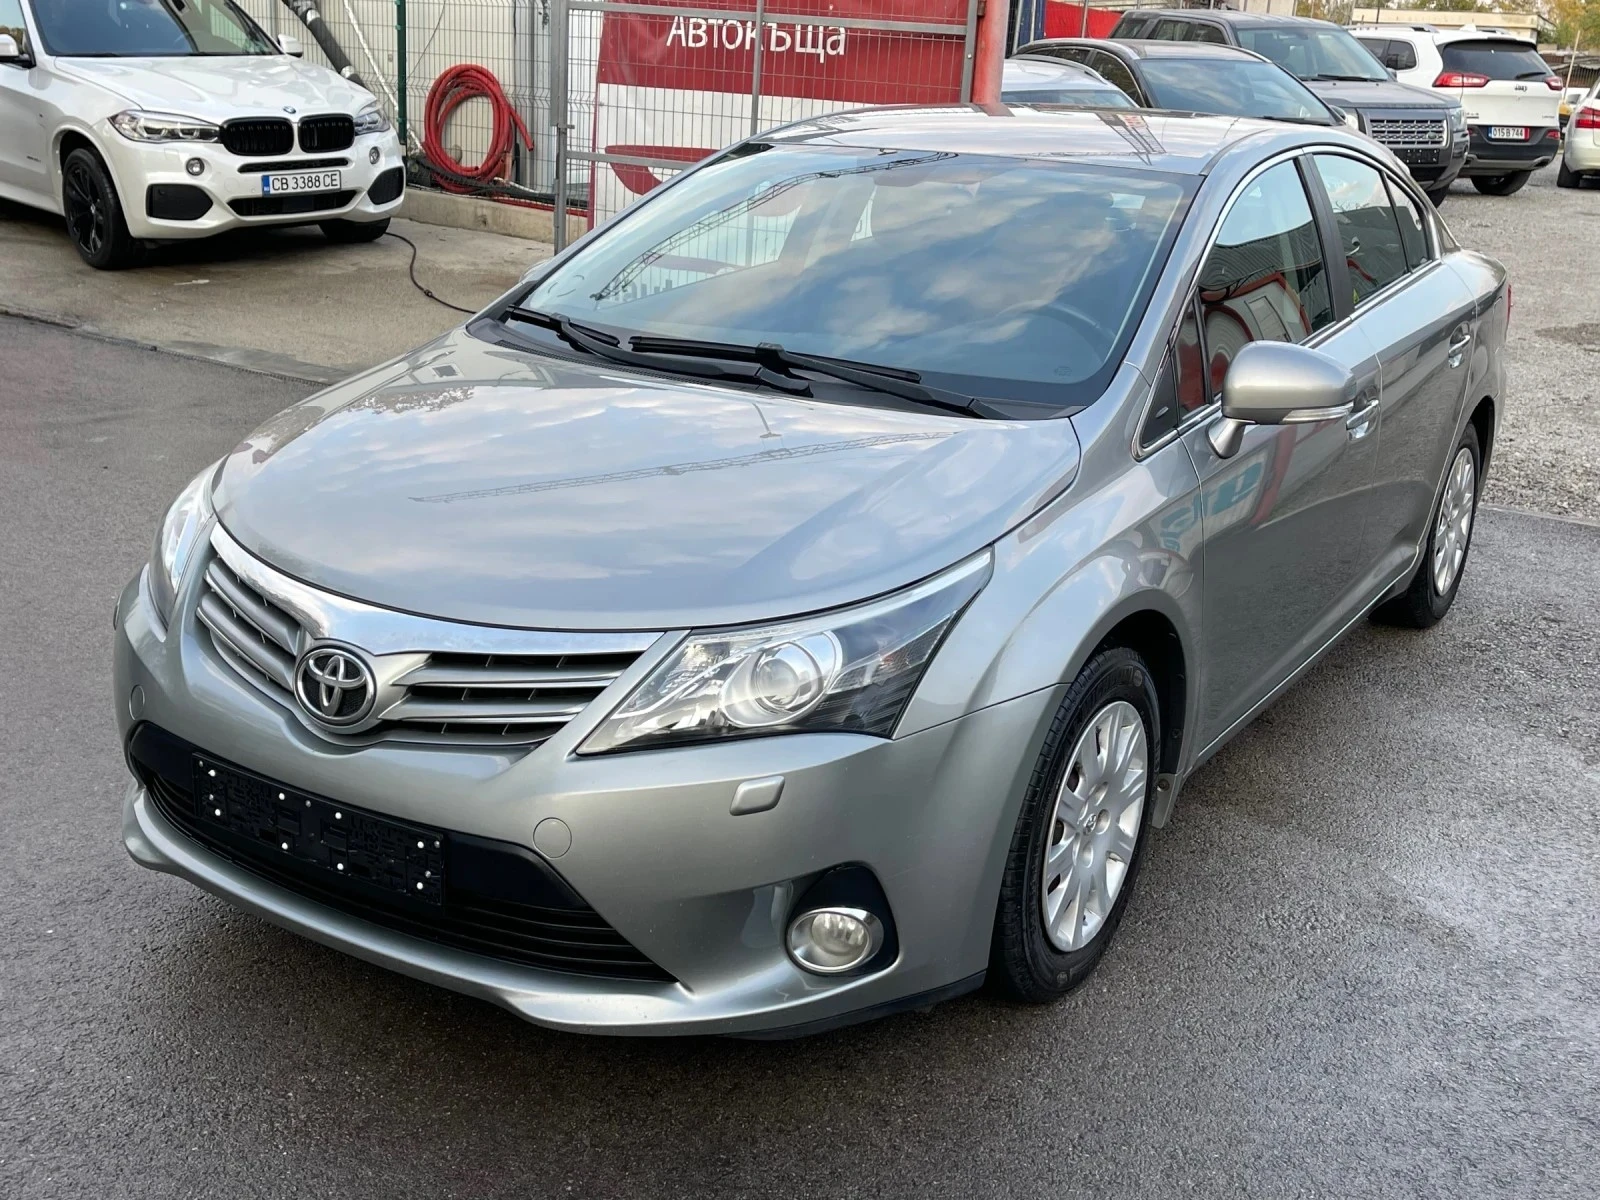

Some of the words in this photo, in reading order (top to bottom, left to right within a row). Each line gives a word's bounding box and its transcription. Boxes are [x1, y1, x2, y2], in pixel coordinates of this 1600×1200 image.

[272, 177, 289, 191] CB
[291, 175, 321, 190] 3388
[323, 173, 338, 188] CE
